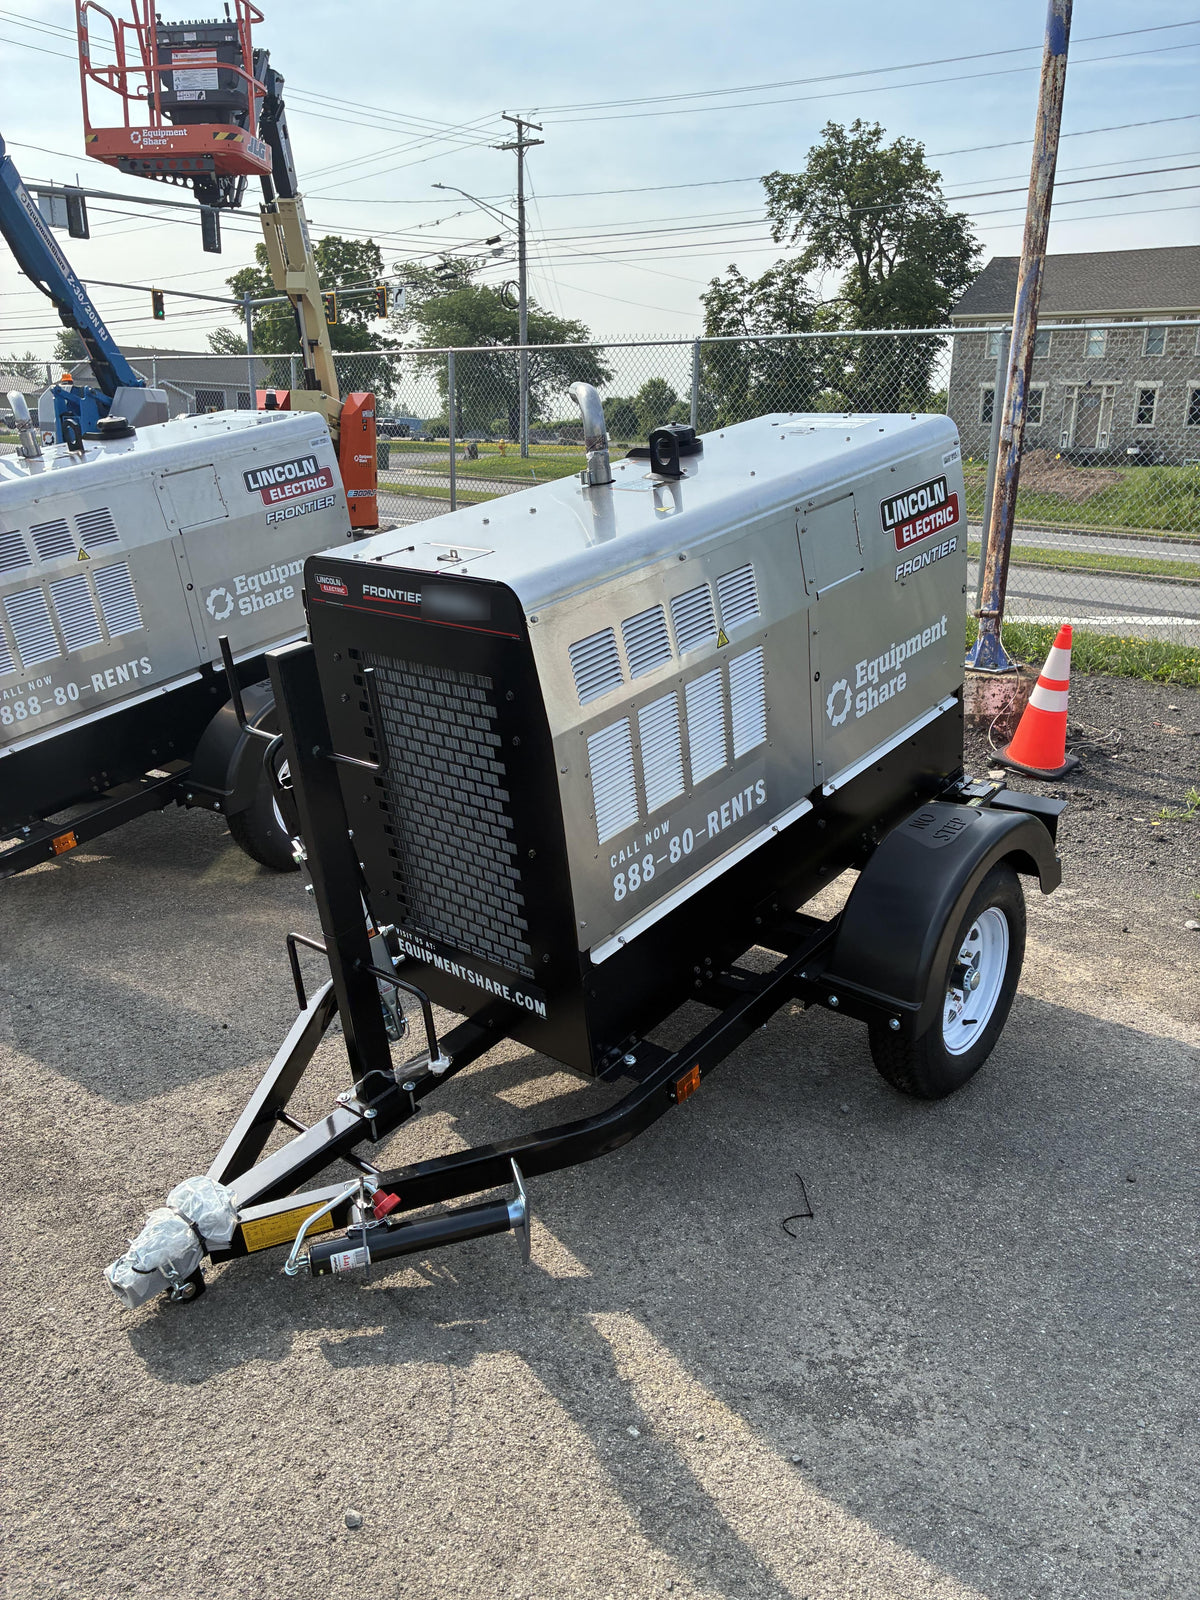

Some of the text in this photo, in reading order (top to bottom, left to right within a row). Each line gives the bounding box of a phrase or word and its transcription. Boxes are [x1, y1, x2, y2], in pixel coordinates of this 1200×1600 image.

[142, 128, 188, 138] Equipment
[142, 137, 168, 146] Share
[246, 136, 267, 161] JLG
[26, 201, 66, 271] EquipmentShare
[67, 274, 108, 342] Z-30/20N RJ
[247, 458, 316, 490] LINCOLN
[269, 475, 327, 501] ELECTRIC
[266, 495, 335, 525] FRONTIER
[884, 480, 946, 527] LINCOLN
[902, 505, 954, 543] ELECTRIC
[895, 536, 957, 582] FRONTIER
[233, 559, 305, 595] Equipm
[316, 575, 341, 586] LINCOLN
[323, 584, 345, 594] ELECTRIC
[238, 585, 295, 616] Share
[855, 614, 948, 689] Equipment
[0, 674, 53, 701] ALL NOW
[0, 656, 152, 725] 888-80-RENTS
[855, 671, 907, 719] Share
[610, 819, 670, 868] CALL NOW
[613, 778, 767, 902] 888-80-RENTS
[908, 813, 966, 841] NO STEP
[395, 927, 413, 940] VISIT
[414, 935, 424, 945] US
[397, 937, 547, 1017] EQUIPMENTSHARE.COM
